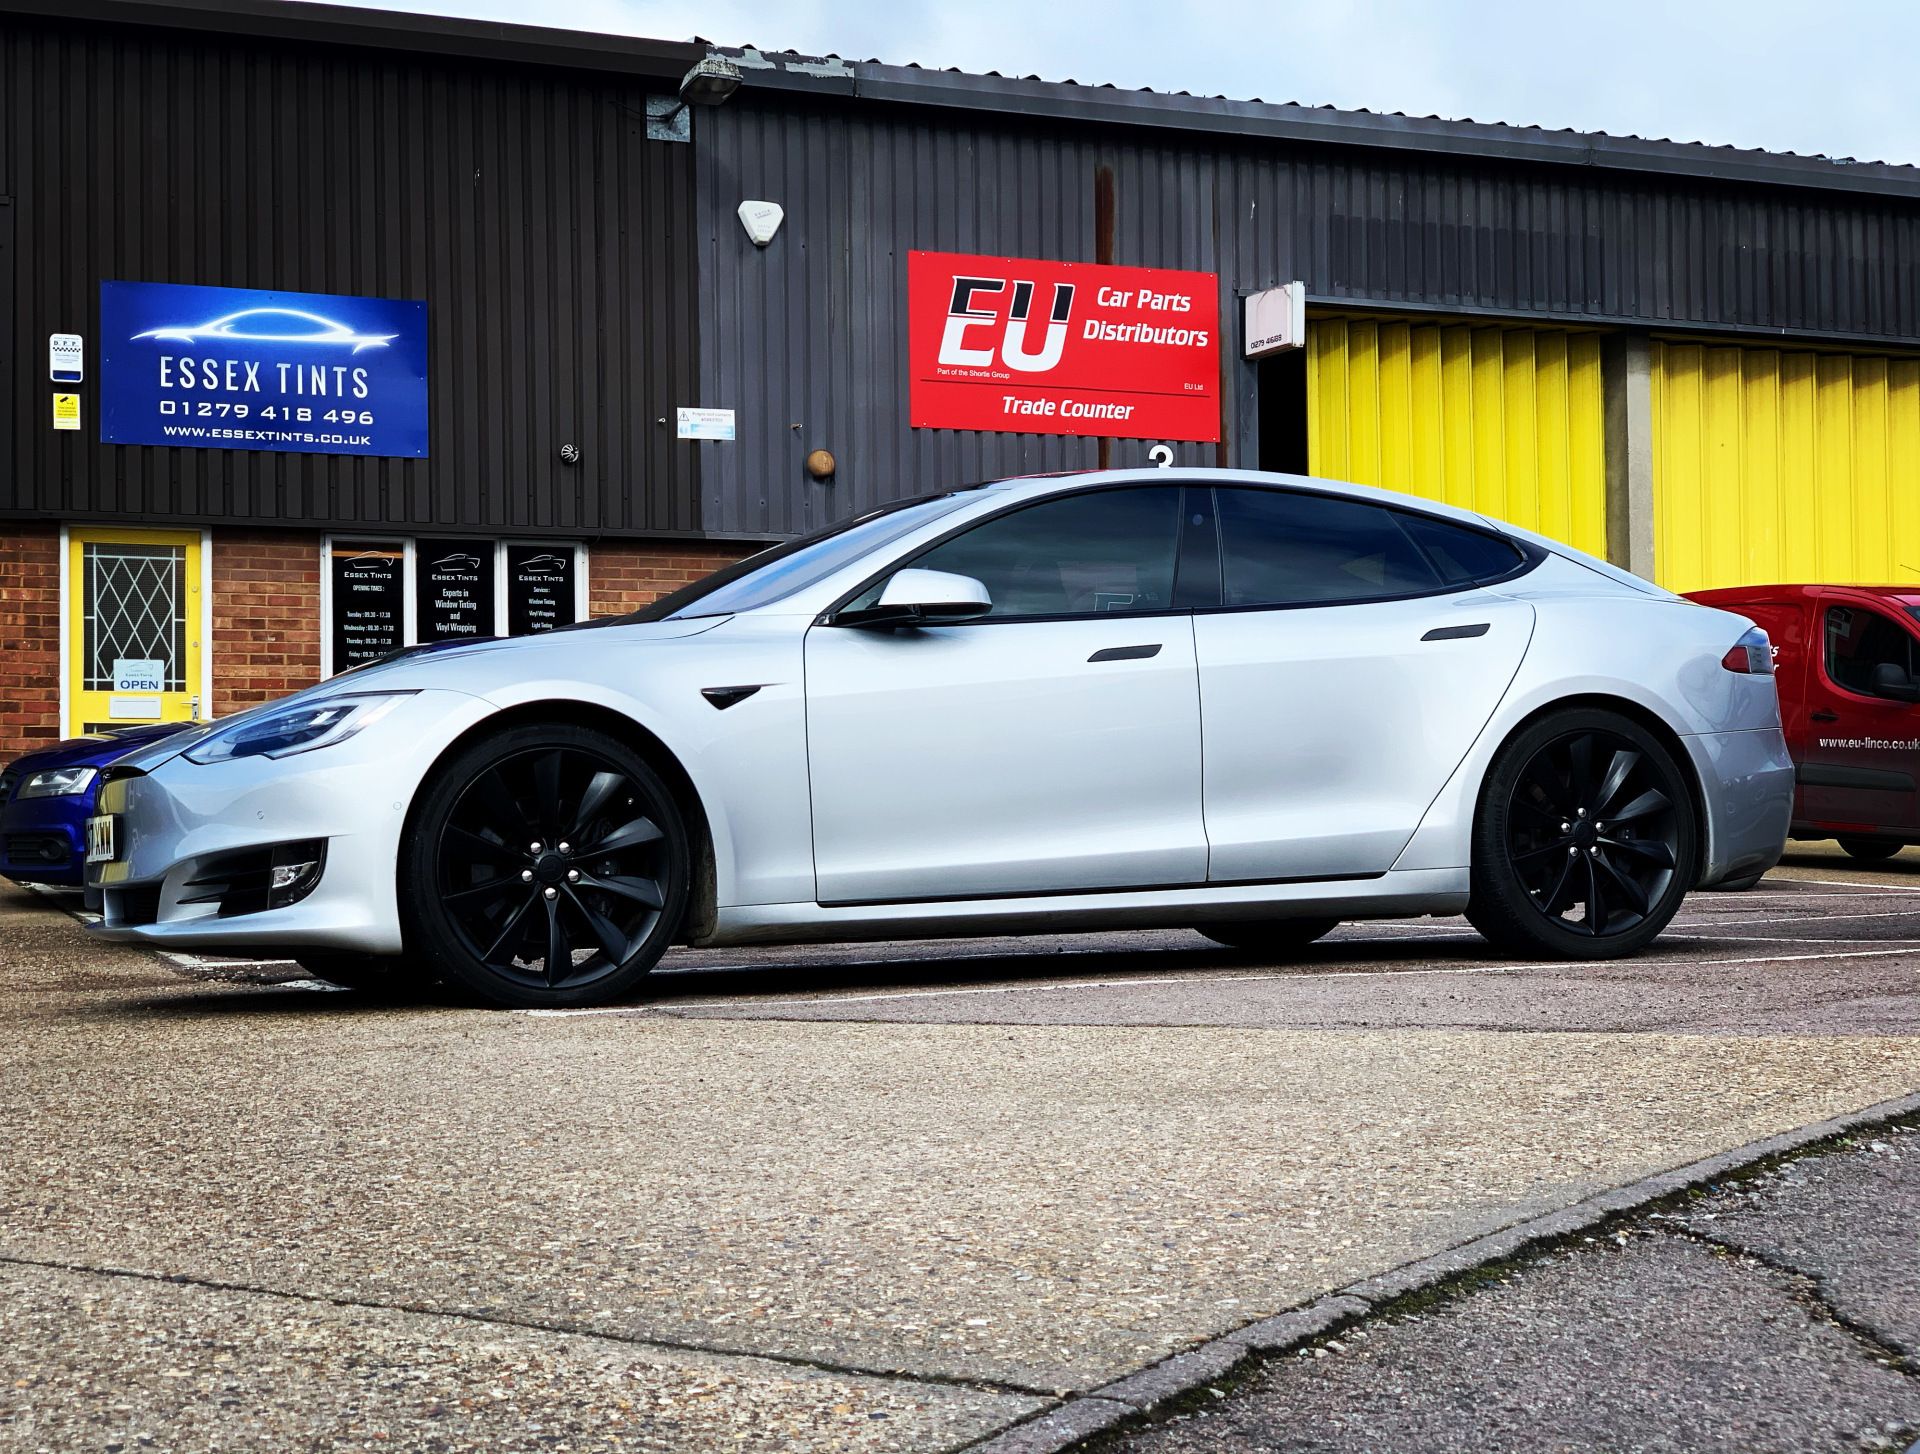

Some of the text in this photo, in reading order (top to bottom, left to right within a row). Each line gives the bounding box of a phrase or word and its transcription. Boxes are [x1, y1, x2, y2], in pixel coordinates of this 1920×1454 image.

[1097, 286, 1191, 312] Car Parts
[938, 275, 1076, 372] EU
[1083, 319, 1208, 347] Distributors
[160, 356, 368, 398] ESSEX TINTS
[937, 367, 950, 375] Part
[958, 369, 969, 377] the
[991, 371, 1010, 380] Group
[1184, 382, 1193, 390] EU
[160, 400, 374, 425] 01279 418 496
[1002, 396, 1134, 420] Trade Counter
[163, 426, 371, 446] WWW.ESSEXTINTS.CO.UK
[344, 571, 369, 579] ESSEX
[443, 588, 469, 598] Experts in
[435, 600, 477, 610] Window Tinting
[450, 611, 460, 620] and
[436, 622, 477, 633] Vinyl Wrapping
[120, 680, 158, 689] OPEN
[1819, 737, 1920, 750] www.eu-linco.co.uk
